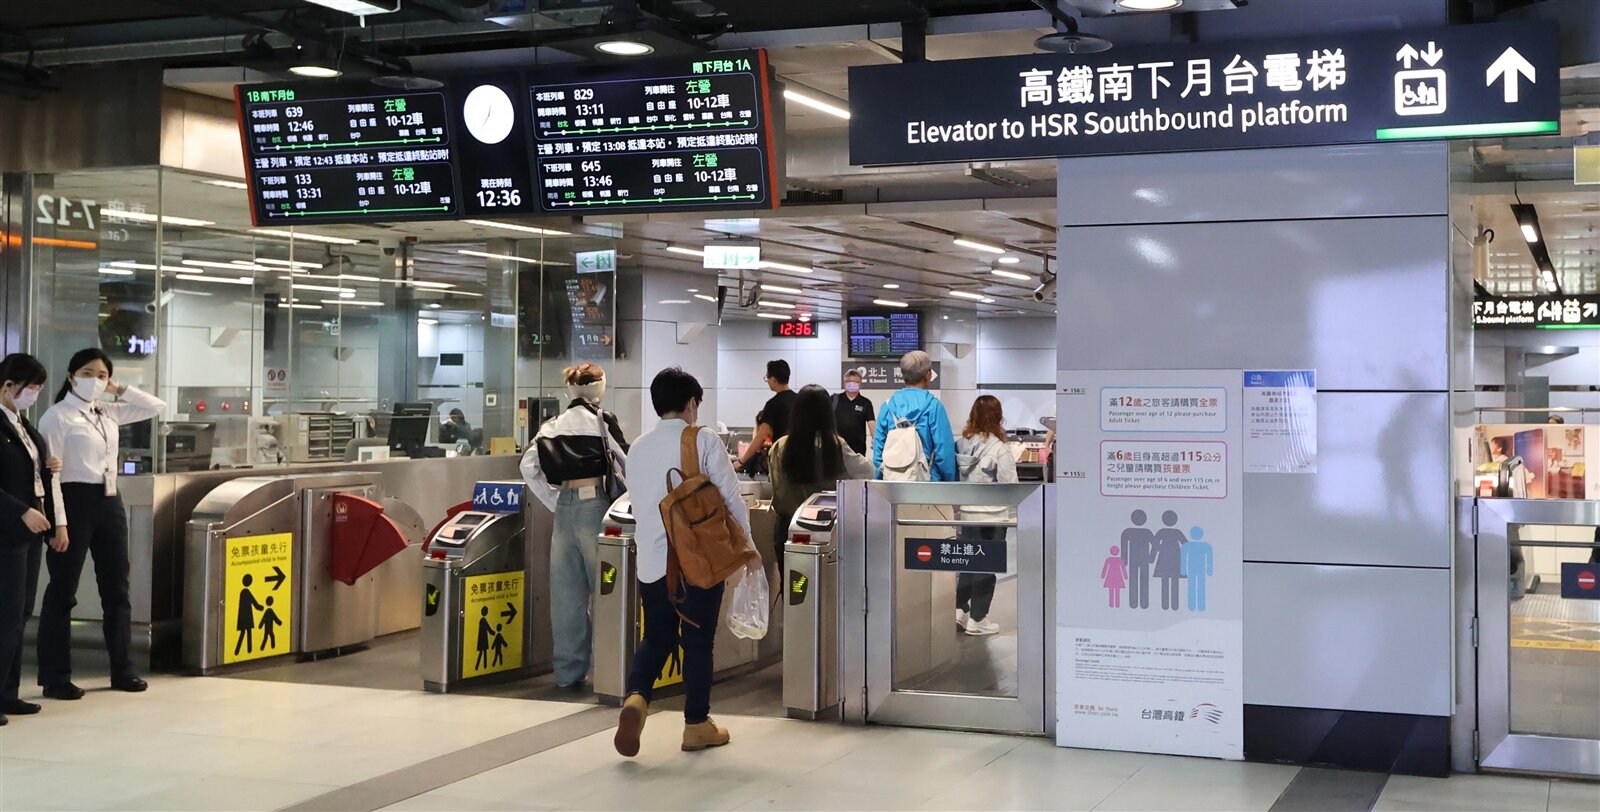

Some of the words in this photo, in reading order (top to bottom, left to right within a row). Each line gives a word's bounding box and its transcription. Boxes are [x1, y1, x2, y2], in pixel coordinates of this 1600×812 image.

[692, 60, 734, 74] 南下月台
[735, 58, 751, 71] 1A
[1018, 48, 1348, 108] 高鐵南下月台電梯
[644, 84, 676, 95] 列車開往
[685, 78, 711, 94] 左營
[247, 91, 260, 102] 1B
[260, 89, 295, 102] 南下月台
[535, 91, 565, 102] 本班列車
[573, 88, 594, 101] 829
[686, 93, 731, 109] 10-12車
[252, 109, 278, 118] 本班列車
[285, 106, 304, 118] 639
[347, 103, 375, 113] 列車開往
[384, 98, 407, 113] 左營
[575, 103, 604, 116] 13:11
[287, 120, 314, 132] 12:46
[385, 112, 424, 127] 10-12車
[907, 119, 997, 144] Elevator
[1001, 118, 1024, 140] to
[1031, 113, 1077, 138] HSR
[1084, 102, 1234, 135] Southbound
[1241, 98, 1348, 133] platform
[602, 141, 626, 152] 13:08
[676, 132, 758, 149] 預定抵達終點站時
[312, 156, 334, 165] 12:43
[377, 149, 449, 163] 預定抵達終點站時
[651, 158, 682, 168] 列車開往
[692, 153, 718, 167] 左營
[543, 162, 572, 173] 下班列車
[581, 160, 601, 172] 645
[294, 173, 312, 185] 133
[356, 171, 383, 181] 列車開往
[391, 167, 415, 181] 左營
[582, 175, 613, 187] 13:46
[694, 167, 738, 182] 10-12車
[393, 181, 432, 195] 10-12車
[480, 177, 512, 189] 現在時刻
[296, 187, 322, 199] 13:31
[476, 189, 521, 207] 12:36
[1476, 315, 1505, 324] S.bound
[1505, 315, 1535, 325] platform
[779, 322, 811, 336] 12:36
[868, 367, 887, 377] 北上
[1109, 396, 1218, 408] 滿12歲之旅客請購買全票
[1107, 450, 1221, 462] 滿6歲且身高超過115公分
[1107, 463, 1191, 473] 之兒童請購買孩童票
[231, 541, 287, 559] 免票孩童先行
[940, 543, 986, 556] 禁止進入
[940, 556, 951, 564] No
[951, 557, 970, 566] entry
[471, 579, 518, 596] 免票孩童先行
[1141, 708, 1185, 722] 台灣高鐵
